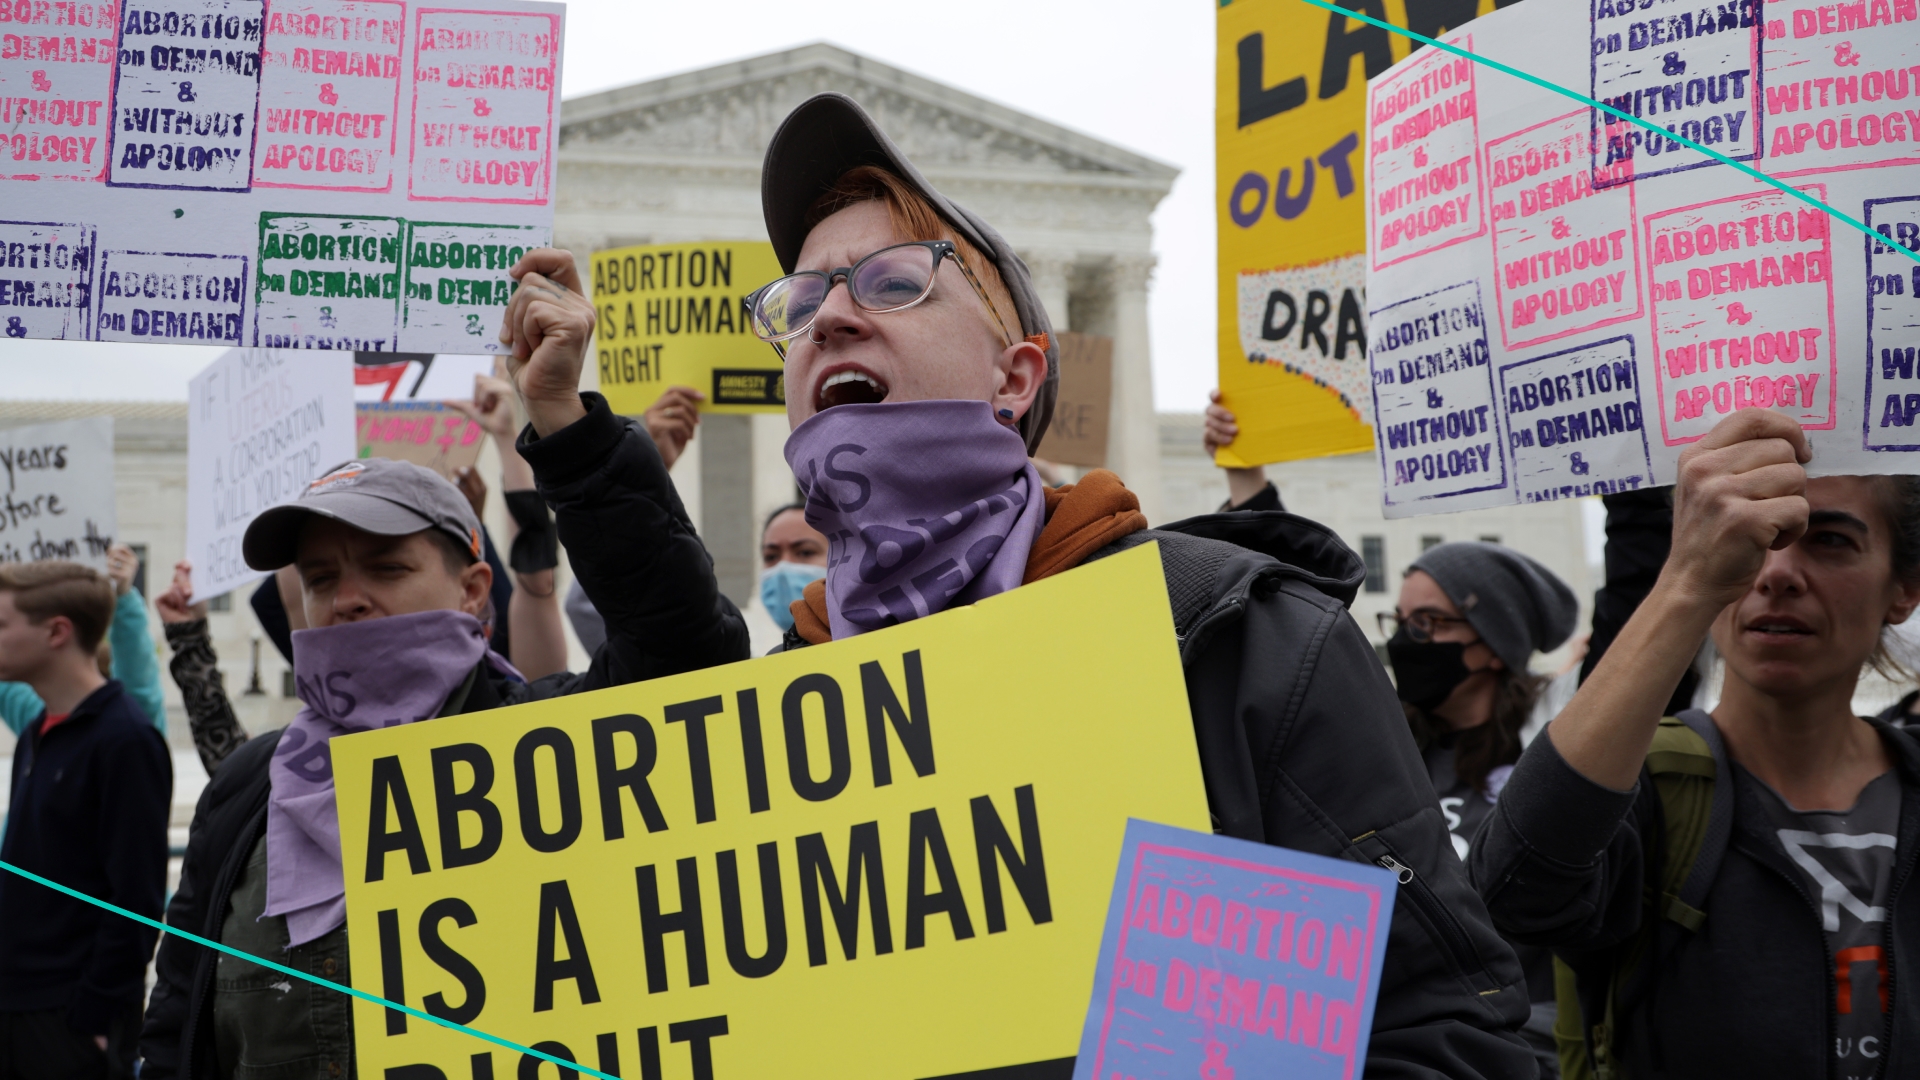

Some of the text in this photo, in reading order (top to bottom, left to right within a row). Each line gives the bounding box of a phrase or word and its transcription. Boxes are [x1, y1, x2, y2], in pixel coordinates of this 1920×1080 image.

[124, 10, 260, 42] ABORTION
[269, 12, 399, 45] ABORTION
[1593, 31, 1622, 56] on
[1628, 0, 1758, 51] DEMAND
[1761, 19, 1786, 40] on
[1, 34, 113, 64] DEMAND
[420, 28, 550, 58] ABORTION
[1834, 41, 1861, 68] &
[119, 45, 261, 76] on DEMAND
[292, 48, 400, 79] DEMAND
[416, 63, 551, 91] on DEMAND
[1662, 52, 1686, 76] &
[31, 70, 52, 92] &
[177, 81, 197, 102] &
[318, 83, 339, 105] &
[1374, 56, 1470, 127] ABORTION
[1601, 69, 1750, 124] WITHOUT
[0, 97, 102, 126] ITHOUT
[123, 107, 244, 137] WITHOUT
[266, 108, 387, 138] WITHOUT
[473, 97, 493, 117] &
[423, 122, 541, 151] WITHOUT
[1372, 90, 1476, 158] on DEMAND
[1606, 110, 1747, 165] APOLOGY
[1770, 109, 1920, 157] APOLOGY
[120, 143, 241, 173] APOLOGY
[262, 144, 382, 174] APOLOGY
[1413, 145, 1429, 168] &
[1493, 121, 1632, 188] ABORTION
[422, 157, 539, 187] APOLOGY
[1229, 131, 1359, 229] OUT
[1379, 155, 1471, 216] WITHOUT
[1493, 158, 1635, 222] on DEMAND
[1381, 193, 1471, 251] APOLOGY
[1551, 215, 1572, 240] &
[1654, 207, 1825, 266] ABORTION
[264, 233, 399, 263] ABORTION
[1504, 229, 1626, 290] WITHOUT
[105, 271, 241, 303] ABORTION
[260, 269, 400, 299] on DEMAND
[595, 249, 732, 296] ABORTION
[1653, 250, 1828, 302] on DEMAND
[1871, 274, 1904, 295] on
[408, 282, 432, 301] on
[1512, 270, 1626, 329] APOLOGY
[6, 316, 27, 338] &
[100, 308, 243, 341] on DEMAND
[319, 306, 338, 329] &
[465, 314, 485, 337] &
[598, 303, 616, 341] IS
[624, 301, 637, 339] A
[1262, 288, 1367, 361] DRA
[1374, 301, 1481, 355] ABORTION
[1726, 302, 1753, 326] &
[600, 344, 663, 385] RIGHT
[1373, 338, 1489, 386] on DEMAND
[1665, 328, 1822, 379] WITHOUT
[1881, 347, 1920, 380] W
[1425, 387, 1443, 408] &
[1509, 360, 1633, 414] ABORTION
[1674, 373, 1820, 422] APOLOGY
[229, 394, 325, 485] CORPORATION
[1387, 405, 1489, 450] WITHOUT
[1510, 400, 1642, 449] on DEMAND
[1394, 442, 1491, 486] APOLOGY
[1570, 451, 1589, 475] &
[365, 649, 936, 884] ABORTION
[378, 783, 1054, 1038] IS A HUMAN
[1131, 884, 1363, 982] ABORTION
[1116, 957, 1355, 1057] on DEMAND
[1199, 1039, 1236, 1080] &
